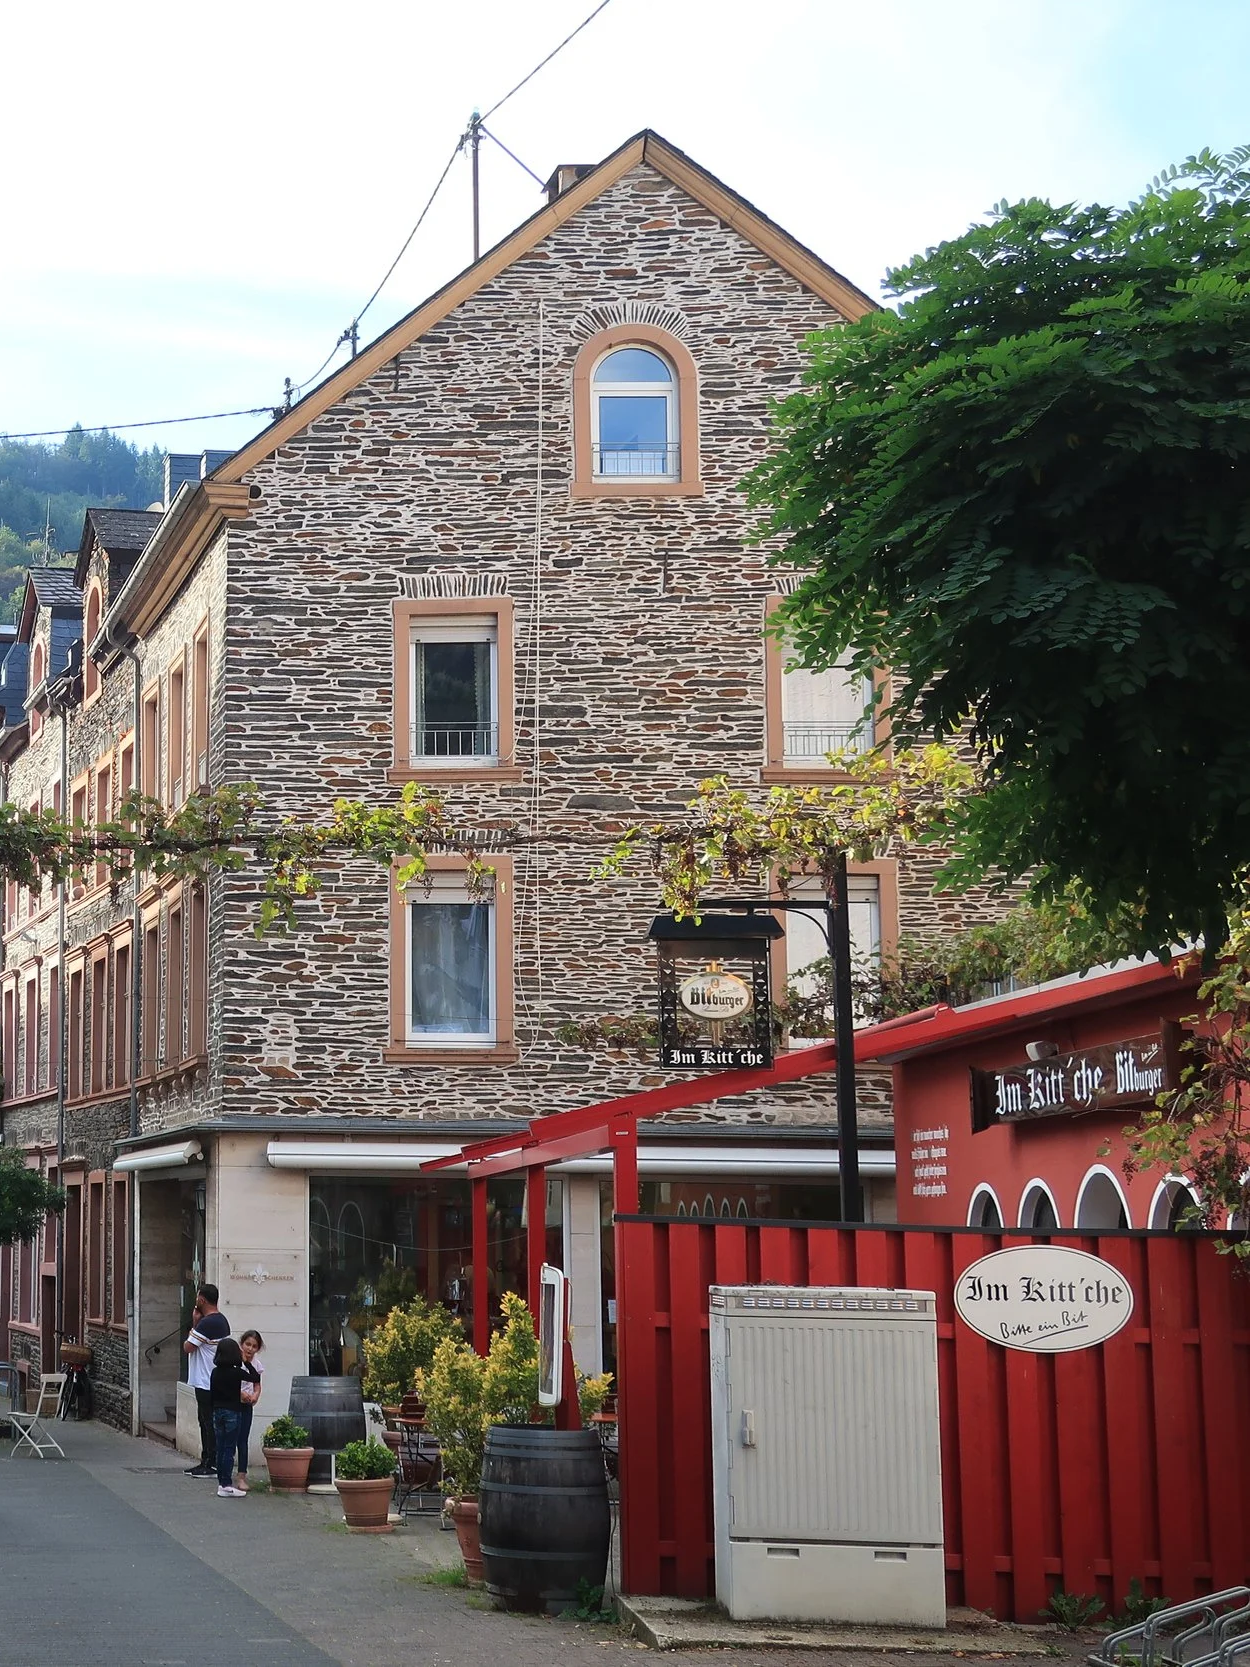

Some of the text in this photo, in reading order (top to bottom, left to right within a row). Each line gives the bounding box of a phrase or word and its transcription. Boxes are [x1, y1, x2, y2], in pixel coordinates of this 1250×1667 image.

[690, 987, 744, 1009] Bitburger
[670, 1049, 696, 1065] Im
[1115, 1050, 1162, 1096] Bitburger
[994, 1075, 1023, 1115] Im
[965, 1275, 1009, 1302] Im
[1000, 1311, 1088, 1339] Bitte ein Bit
